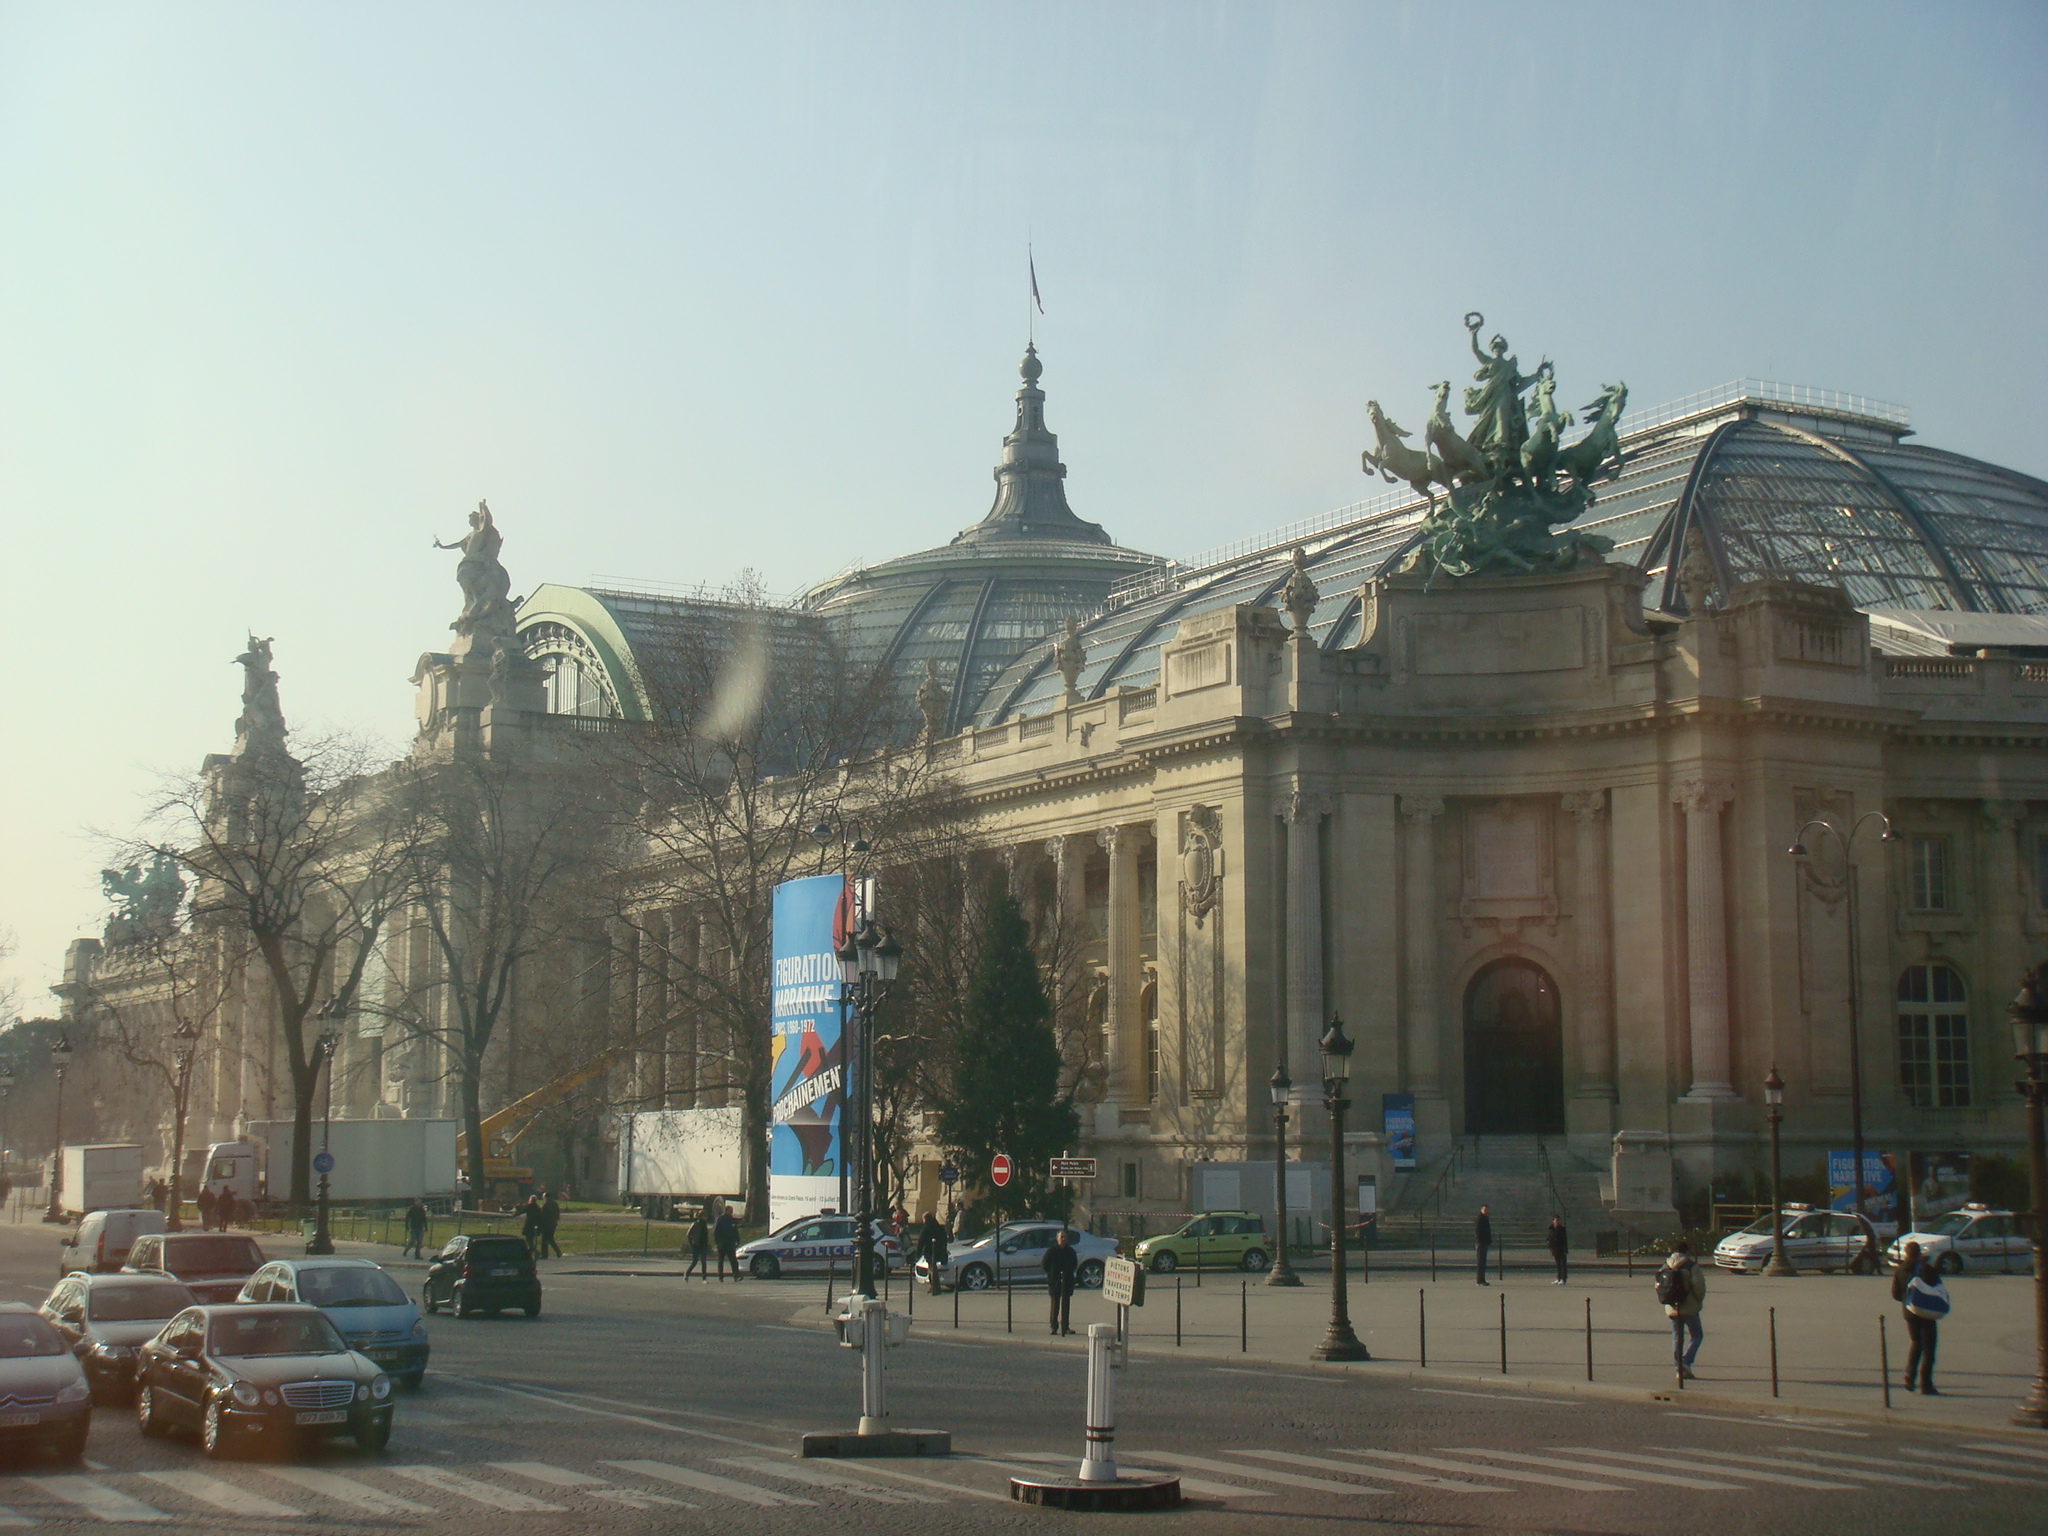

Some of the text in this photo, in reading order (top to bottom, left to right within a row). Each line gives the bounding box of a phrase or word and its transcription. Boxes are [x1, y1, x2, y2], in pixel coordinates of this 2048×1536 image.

[776, 952, 842, 987] FIGURATION
[775, 984, 834, 1018] NARRATIVE
[1833, 1158, 1886, 1170] FIGUATION
[793, 1246, 851, 1257] POLICE
[1107, 1270, 1131, 1282] ATTENTION
[1105, 1279, 1131, 1292] TRAVERSEZ
[1115, 1291, 1130, 1301] TEMPS
